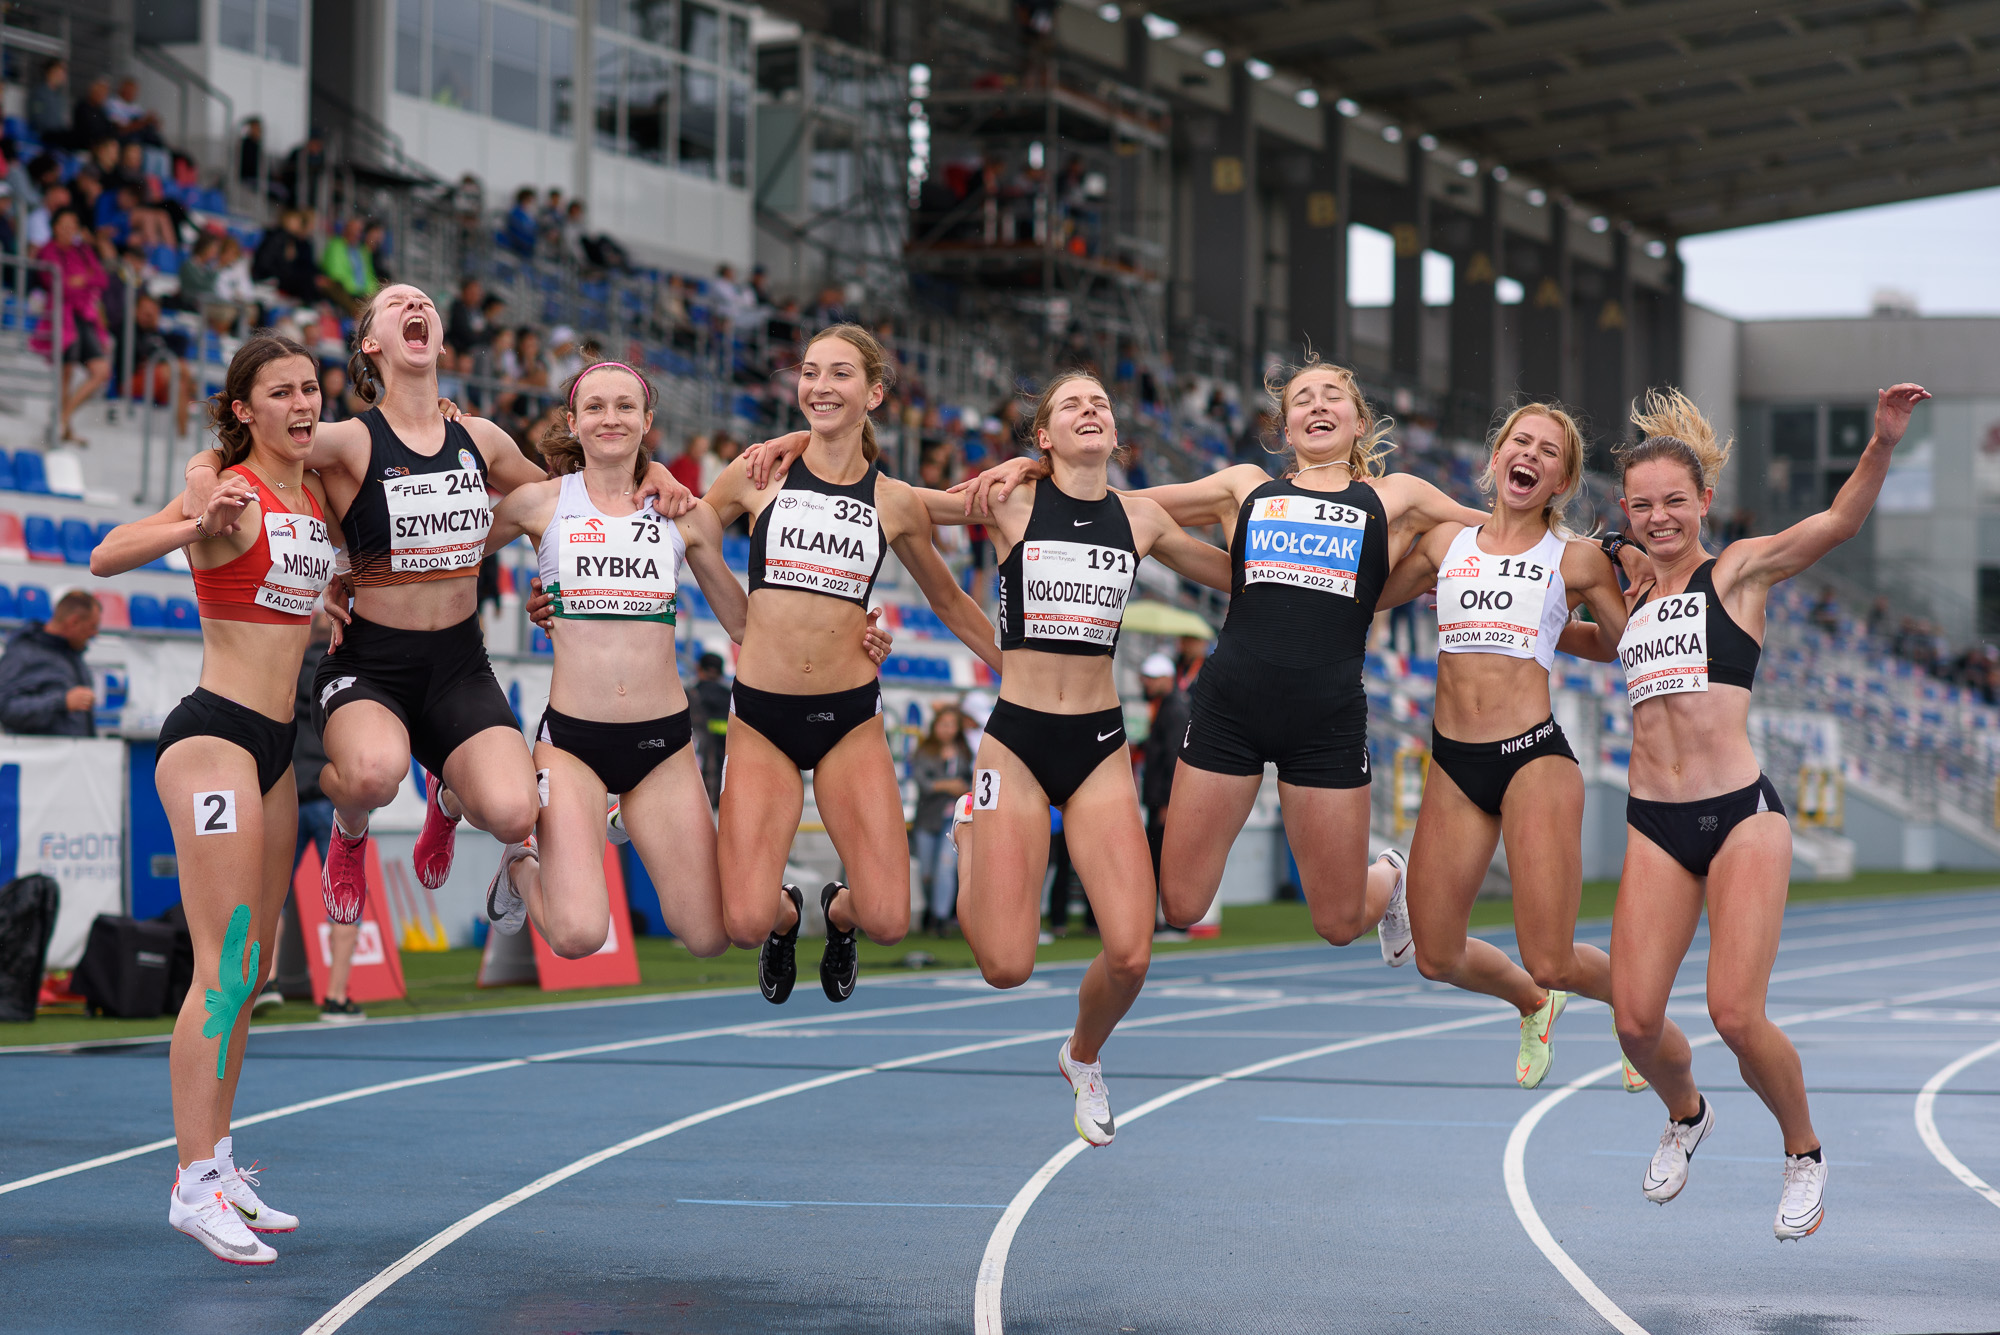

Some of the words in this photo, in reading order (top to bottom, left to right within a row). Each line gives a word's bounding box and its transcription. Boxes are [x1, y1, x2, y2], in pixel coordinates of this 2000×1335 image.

[403, 484, 437, 497] FUEL
[445, 472, 483, 495] 244
[396, 508, 490, 538] SZYMCZYK
[834, 500, 873, 528] 325
[1314, 503, 1359, 524] 135
[270, 529, 292, 538] polanik
[309, 520, 330, 546] 254
[571, 534, 604, 542] ORLEN
[631, 521, 660, 544] 73
[780, 526, 865, 562] KLAMA
[1251, 529, 1358, 561] WOŁCZAK
[283, 553, 330, 581] MISIAK
[401, 556, 451, 569] RADOM
[454, 551, 477, 565] 2022
[576, 556, 660, 579] RYBKA
[784, 561, 833, 574] MISTRZOSTWA
[834, 569, 856, 579] POLSKI
[1087, 548, 1128, 574] 191
[1263, 561, 1315, 572] MISTRZOSTWA
[1315, 567, 1340, 576] POLSKI
[1341, 571, 1355, 579] U20
[1498, 558, 1544, 581] 115
[772, 570, 818, 586] RADOM
[822, 577, 849, 592] 2022
[1252, 569, 1299, 582] RADOM
[1303, 574, 1334, 588] 2022
[1448, 569, 1478, 577] ORLEN
[265, 592, 305, 611] RADOM
[633, 591, 658, 599] POLSKI
[1027, 579, 1127, 610] KOŁODZIEJCZUK
[1460, 589, 1513, 610] OKO
[570, 599, 619, 610] RADOM
[623, 600, 652, 612] 2022
[1657, 597, 1699, 622] 626
[1044, 614, 1092, 623] MISTRZOSTWA
[1455, 621, 1495, 629] MISTRZOSTWA
[1496, 622, 1521, 632] POLSKI
[1032, 624, 1079, 636] RADOM
[1083, 627, 1104, 640] 2022
[1445, 631, 1480, 645] RADOM
[1485, 631, 1515, 645] 2022
[1620, 632, 1703, 672] KORNACKA
[1664, 668, 1689, 676] POLSKI
[1629, 683, 1653, 702] RADOM
[1656, 678, 1684, 692] 2022
[806, 711, 835, 723] esa
[638, 738, 666, 750] esa
[1501, 733, 1534, 755] NIKE
[979, 771, 992, 807] 3
[203, 794, 228, 831] 2
